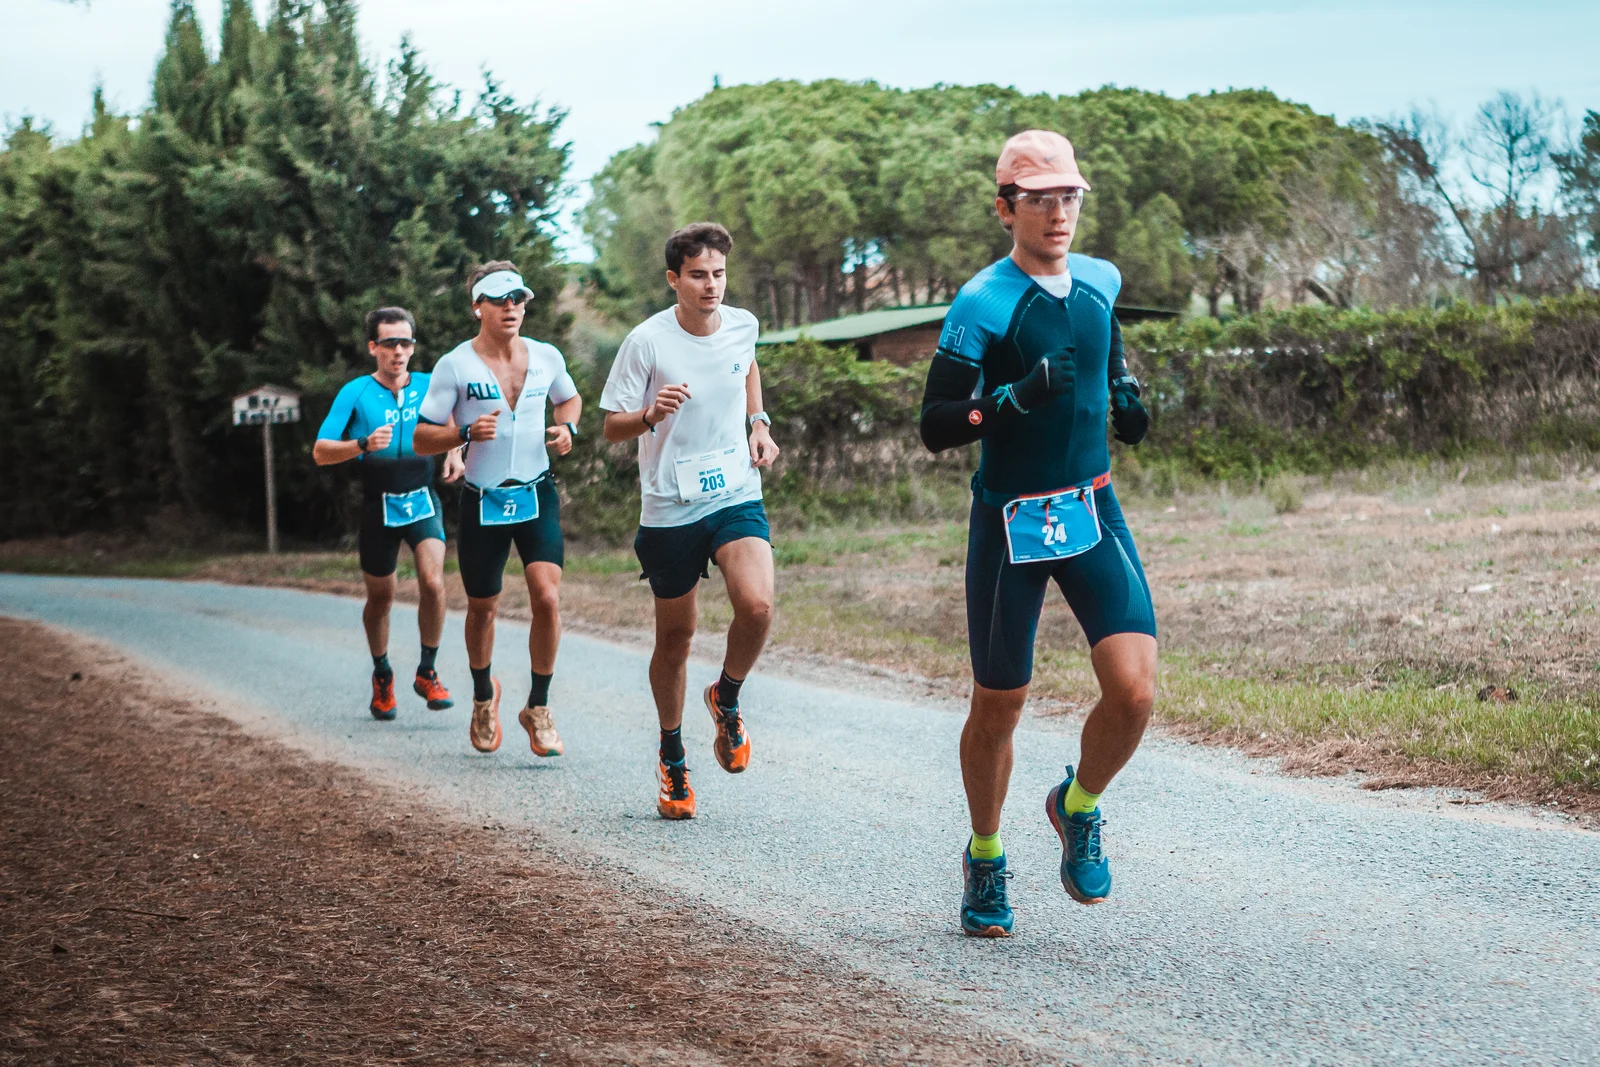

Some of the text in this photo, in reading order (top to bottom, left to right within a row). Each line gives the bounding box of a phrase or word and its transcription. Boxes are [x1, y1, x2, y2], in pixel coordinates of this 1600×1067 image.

[700, 473, 725, 493] 203
[503, 504, 517, 517] 27
[1041, 523, 1067, 545] 24
